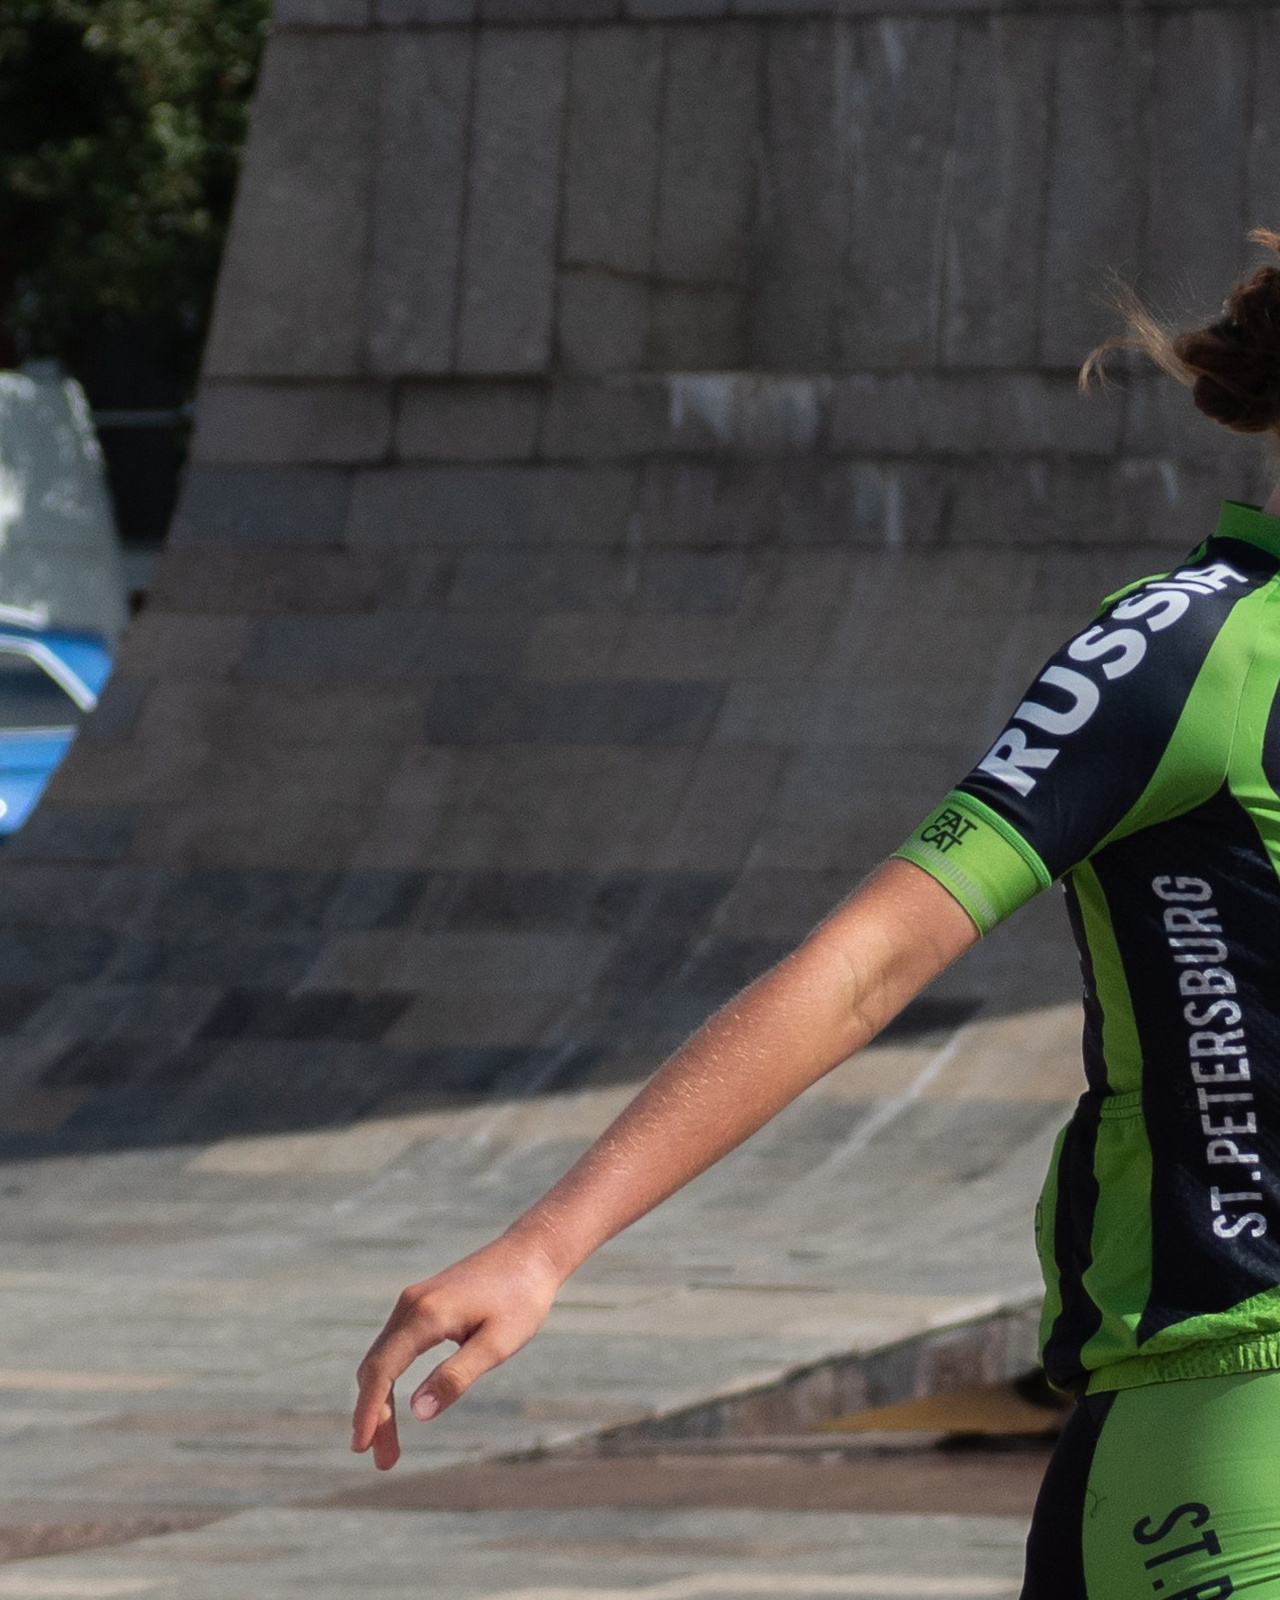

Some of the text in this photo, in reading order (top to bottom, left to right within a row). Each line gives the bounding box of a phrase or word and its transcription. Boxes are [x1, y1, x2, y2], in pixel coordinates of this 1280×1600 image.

[977, 562, 1249, 798] RUSSIA
[921, 824, 963, 854] CAT
[934, 808, 978, 839] FAT
[1152, 874, 1268, 1240] ST.PETERSBURG
